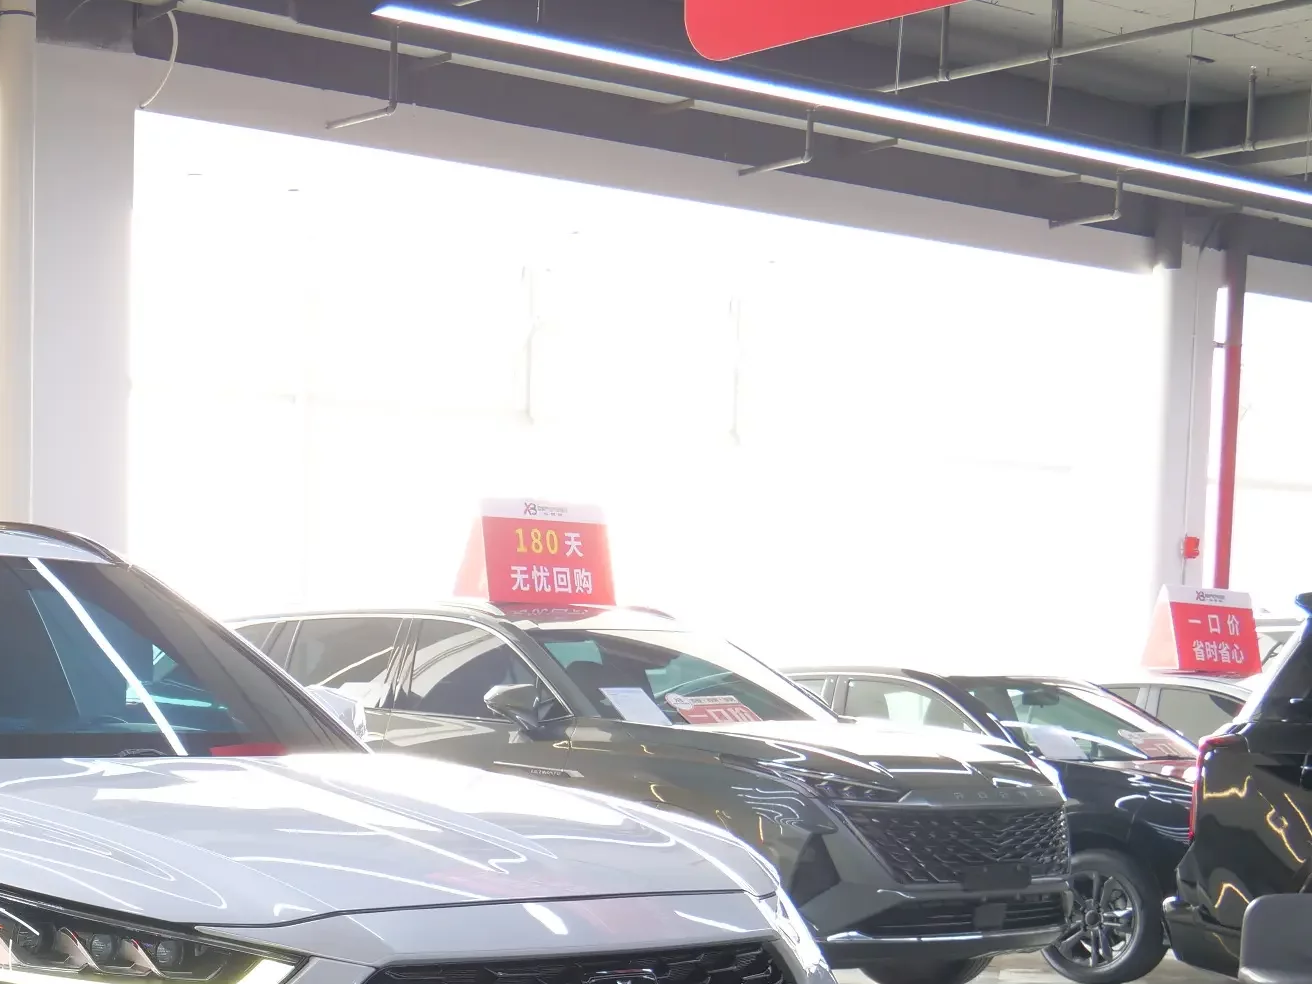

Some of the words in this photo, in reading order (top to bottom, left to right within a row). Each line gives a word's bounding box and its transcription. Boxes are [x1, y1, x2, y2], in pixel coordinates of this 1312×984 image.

[511, 565, 593, 595] 无忧回购
[1188, 614, 1240, 636] 一口价
[1192, 640, 1245, 664] 省时省心
